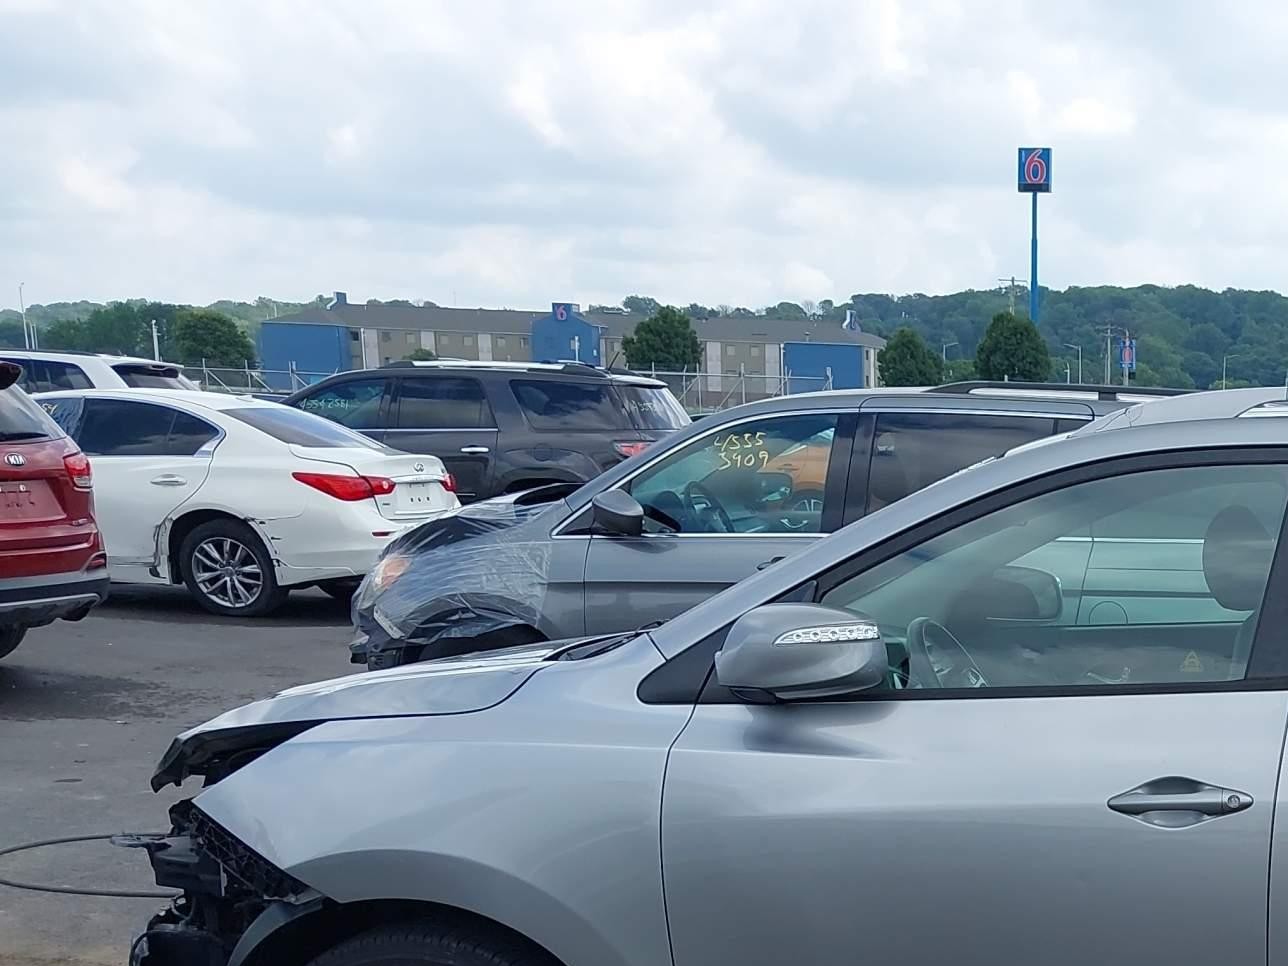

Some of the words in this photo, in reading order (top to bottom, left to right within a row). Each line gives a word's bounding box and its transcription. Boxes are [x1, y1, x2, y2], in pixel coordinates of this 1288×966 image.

[1024, 149, 1047, 184] 6
[556, 304, 567, 321] 6
[8, 455, 25, 465] KIA
